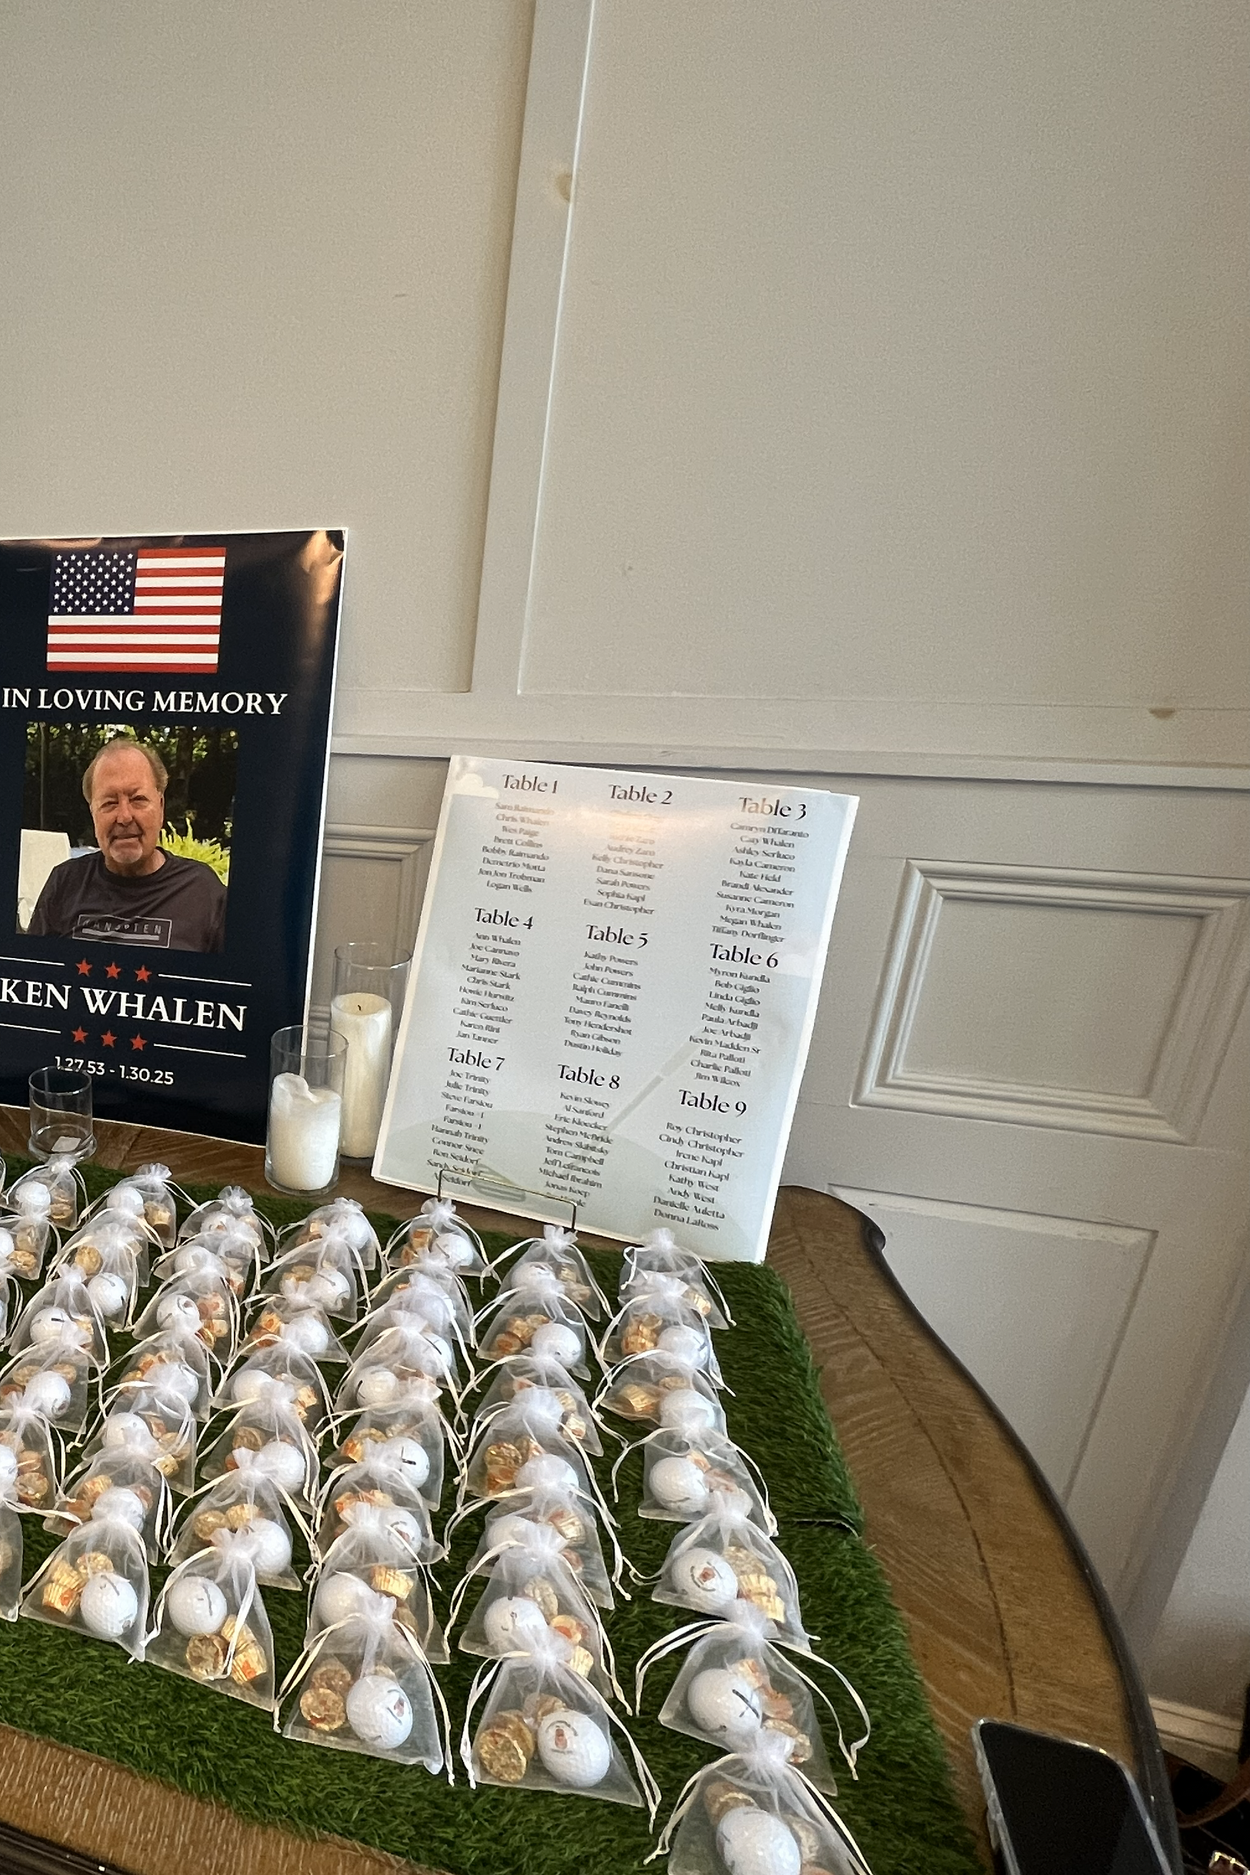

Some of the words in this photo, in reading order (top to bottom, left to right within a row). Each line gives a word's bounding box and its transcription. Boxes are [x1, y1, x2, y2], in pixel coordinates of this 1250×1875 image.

[2, 687, 30, 709] IN
[38, 688, 145, 712] LOVING
[152, 691, 288, 715] MEMORY
[502, 774, 548, 792] Table
[608, 784, 657, 803] Table
[661, 790, 673, 805] 2
[739, 797, 791, 817] Table
[795, 803, 807, 821] 3
[474, 907, 520, 927] Table
[523, 916, 533, 930] 4
[586, 925, 634, 945] Table
[637, 932, 648, 948] 5
[710, 943, 762, 966] Table
[766, 952, 778, 968] 6
[0, 977, 71, 1010] KEN
[81, 986, 248, 1032] WHALEN
[448, 1047, 491, 1069] Table
[496, 1057, 505, 1071] 7
[55, 1056, 105, 1076] 1.2753
[119, 1065, 174, 1085] 1.30.25
[465, 1072, 490, 1084] Trinity
[558, 1064, 605, 1087] Table
[608, 1075, 620, 1090] 8
[465, 1084, 490, 1096] Trinity
[678, 1089, 730, 1113] Table
[735, 1101, 747, 1118] 9
[464, 1131, 489, 1144] Trinity
[666, 1122, 682, 1132] Roy
[685, 1126, 742, 1144] Christopher
[659, 1134, 684, 1146] Cindy
[688, 1139, 744, 1158] Christopher
[676, 1150, 698, 1161] Irene
[664, 1161, 707, 1176] Christian
[669, 1174, 694, 1187] Kathy
[698, 1180, 719, 1192] West
[668, 1187, 689, 1199] Andy
[693, 1192, 715, 1204] West
[654, 1209, 684, 1223] Donna
